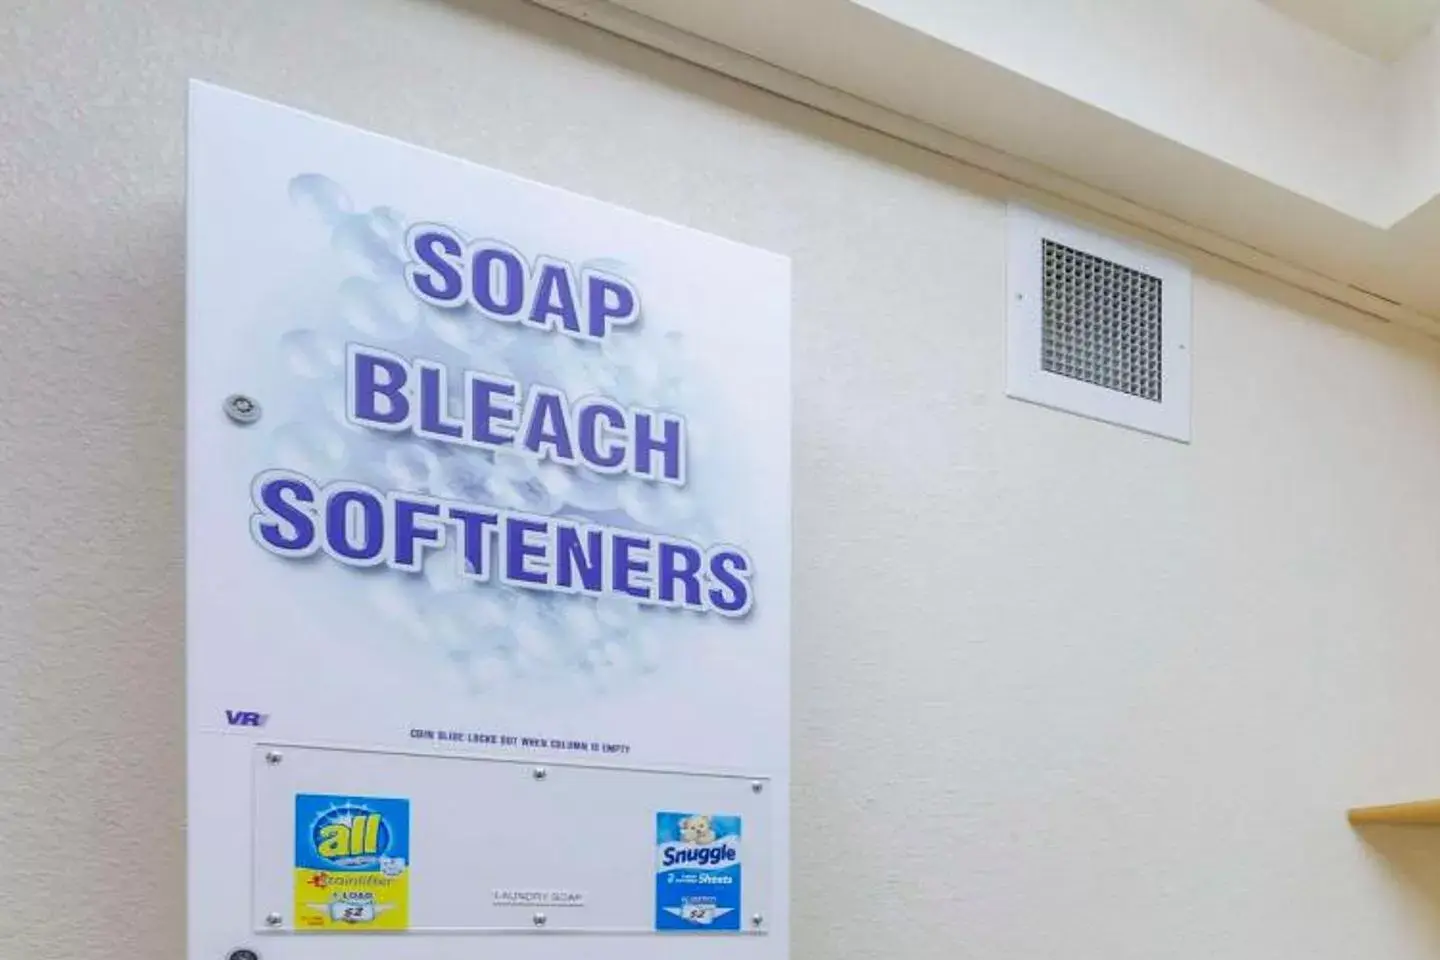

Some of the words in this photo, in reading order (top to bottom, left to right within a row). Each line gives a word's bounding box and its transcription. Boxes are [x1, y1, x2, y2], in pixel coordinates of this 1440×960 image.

[411, 229, 636, 339] SOAP
[352, 352, 684, 481] BLEACH
[257, 477, 754, 614] SOFTENERS
[409, 728, 435, 741] COIN
[500, 735, 518, 747] OUT
[521, 736, 548, 748] WHEN
[550, 738, 589, 751] COLUMN
[590, 742, 600, 752] IS
[602, 742, 631, 755] EMPTY
[318, 813, 382, 857] all
[661, 844, 737, 867] Snuggle
[698, 872, 734, 885] Sheets
